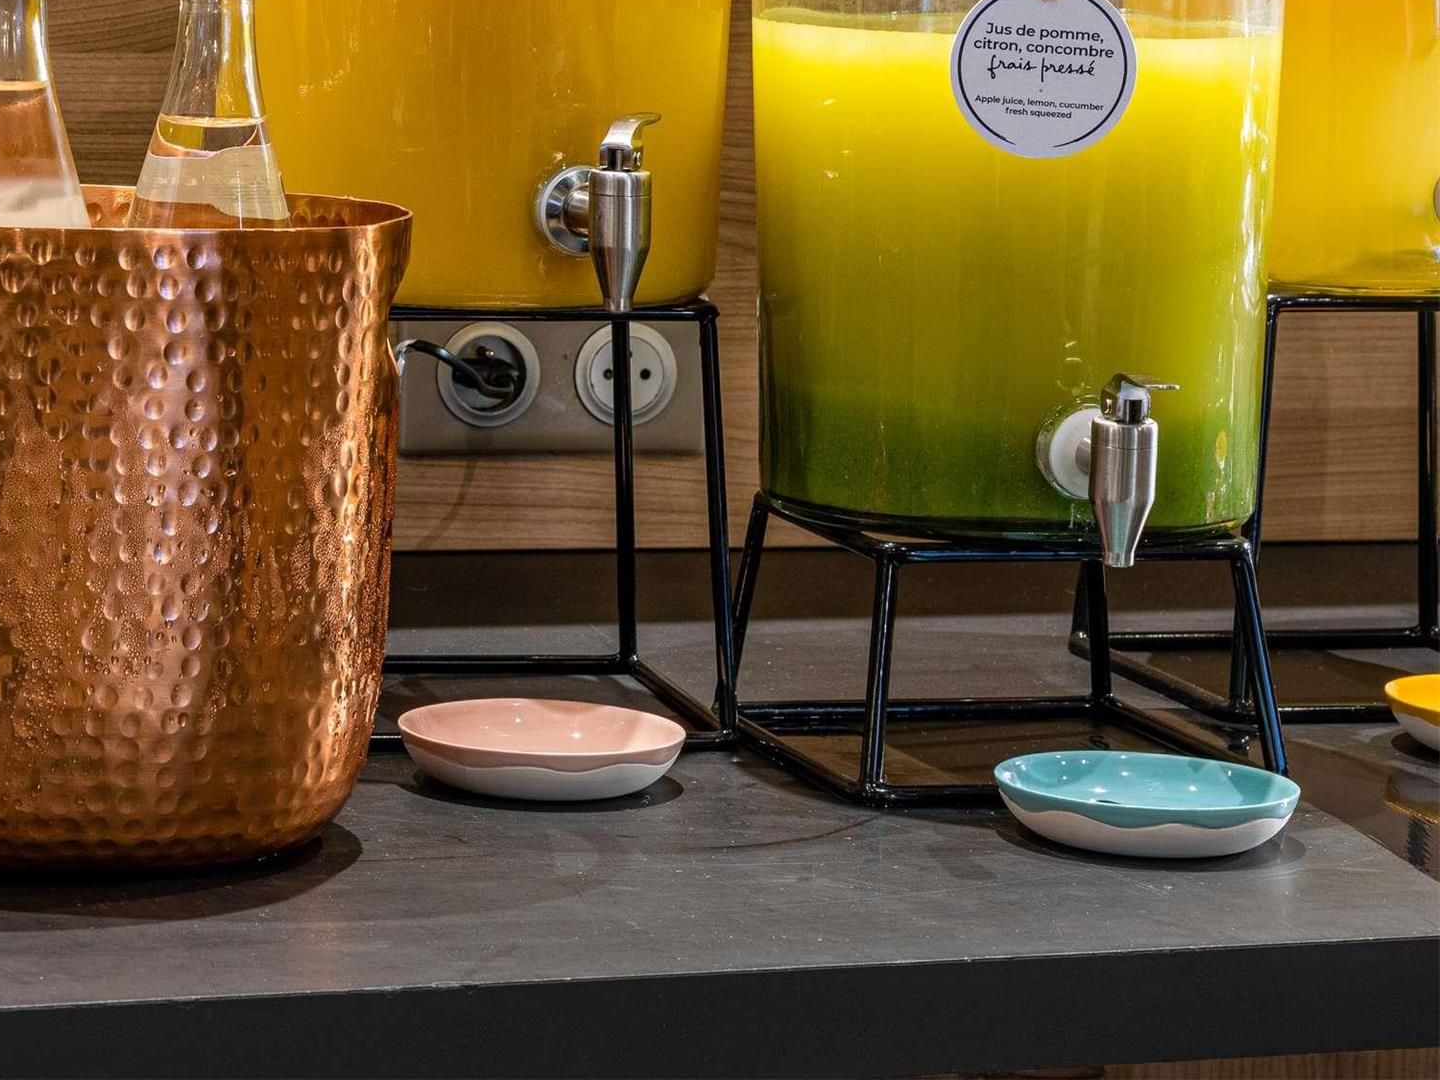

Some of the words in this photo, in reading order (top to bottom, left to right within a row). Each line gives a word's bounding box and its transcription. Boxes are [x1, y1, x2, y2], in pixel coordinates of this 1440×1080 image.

[985, 22, 1012, 36] Jus
[1016, 24, 1036, 38] de
[1039, 28, 1104, 45] pomme,
[973, 37, 1023, 54] citron,
[1026, 43, 1115, 59] concombre
[987, 54, 1038, 80] frais
[1040, 57, 1096, 83] pressé
[974, 94, 1001, 105] Apple
[1002, 95, 1026, 107] juice,
[1027, 97, 1058, 108] lemon,
[1059, 101, 1104, 111] cucumber
[1005, 106, 1028, 116] fresh
[1029, 108, 1072, 119] squeezed
